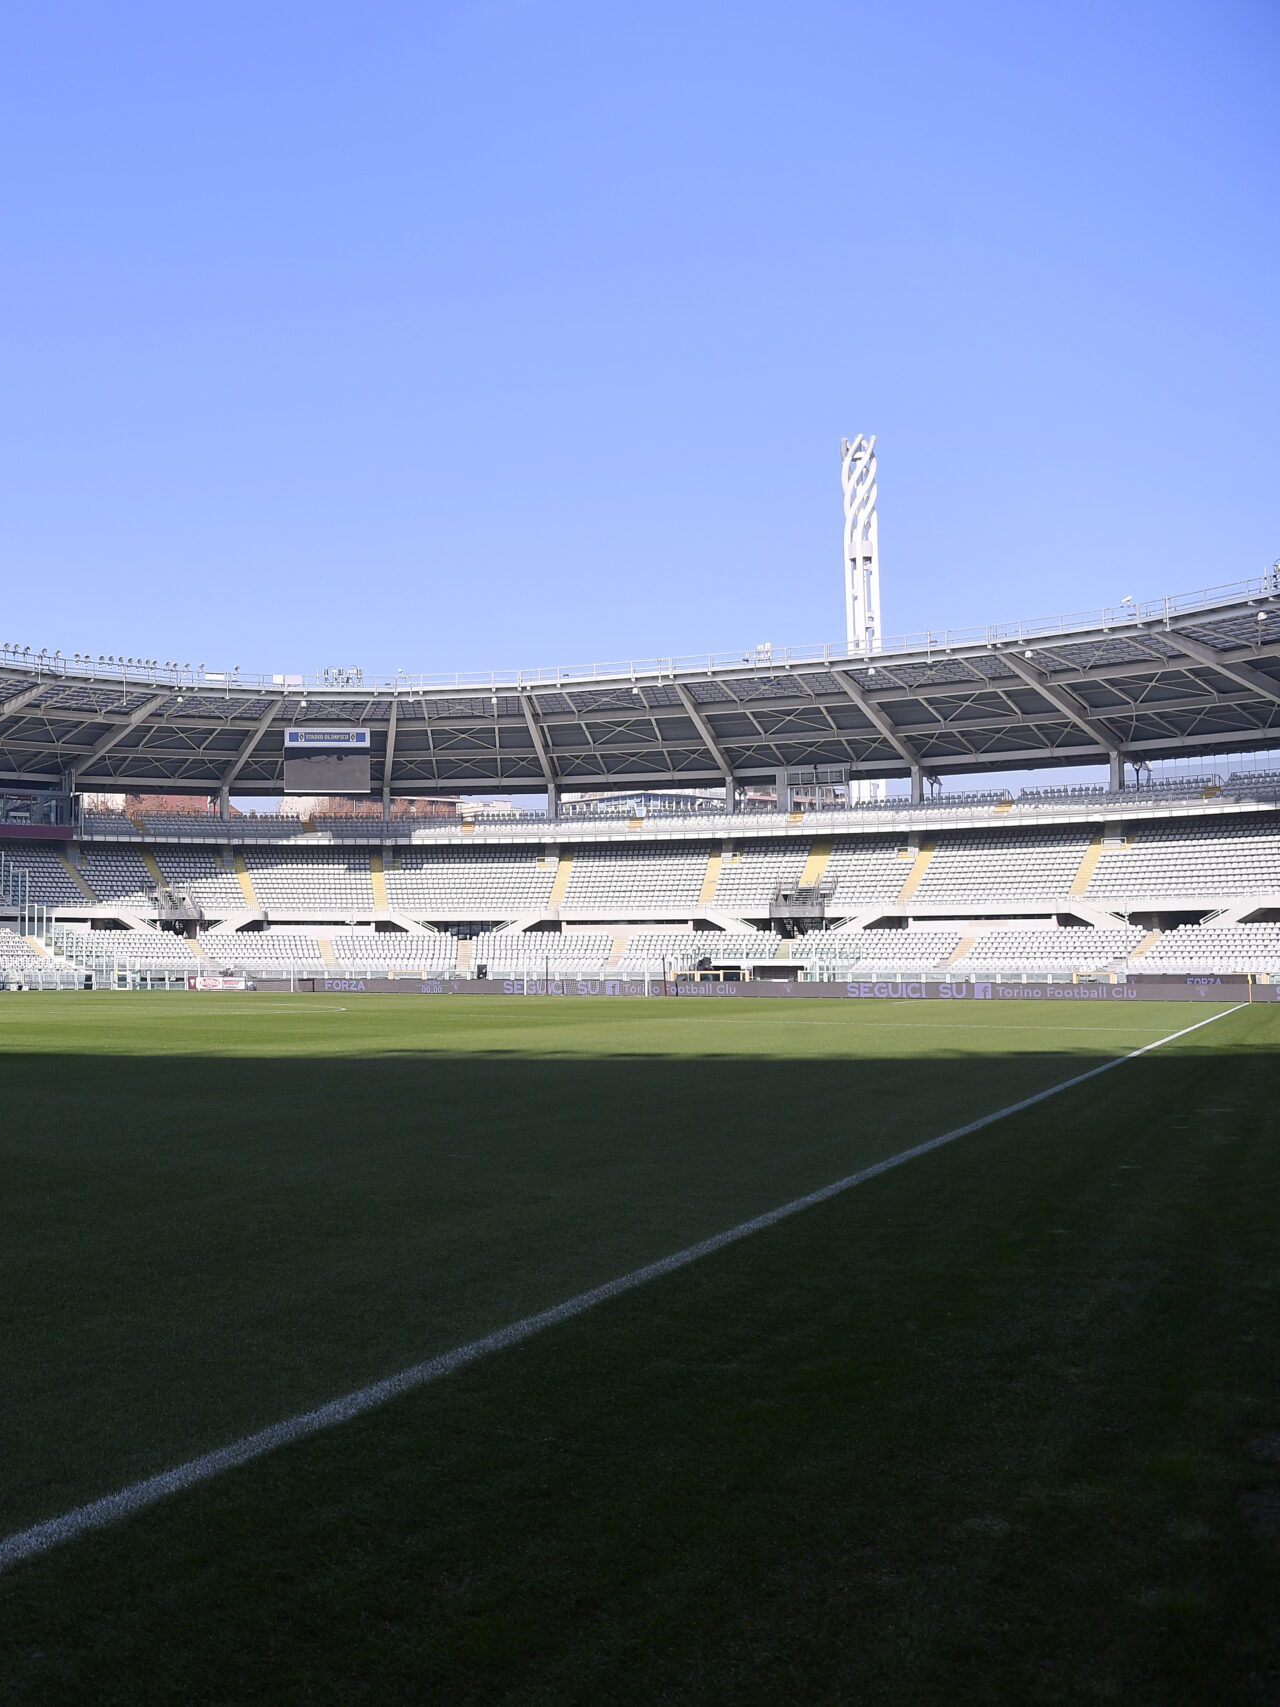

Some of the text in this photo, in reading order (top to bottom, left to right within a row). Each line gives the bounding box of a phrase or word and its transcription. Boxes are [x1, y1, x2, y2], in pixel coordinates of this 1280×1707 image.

[324, 981, 366, 991] FORZA
[503, 980, 567, 994] SEGUICI
[577, 981, 600, 995] SU
[716, 983, 736, 994] Clu
[847, 983, 926, 998] SEGUICI
[939, 983, 966, 998] SU
[996, 986, 1042, 998] Torino
[1047, 985, 1107, 998] Football
[1112, 986, 1137, 998] Clu
